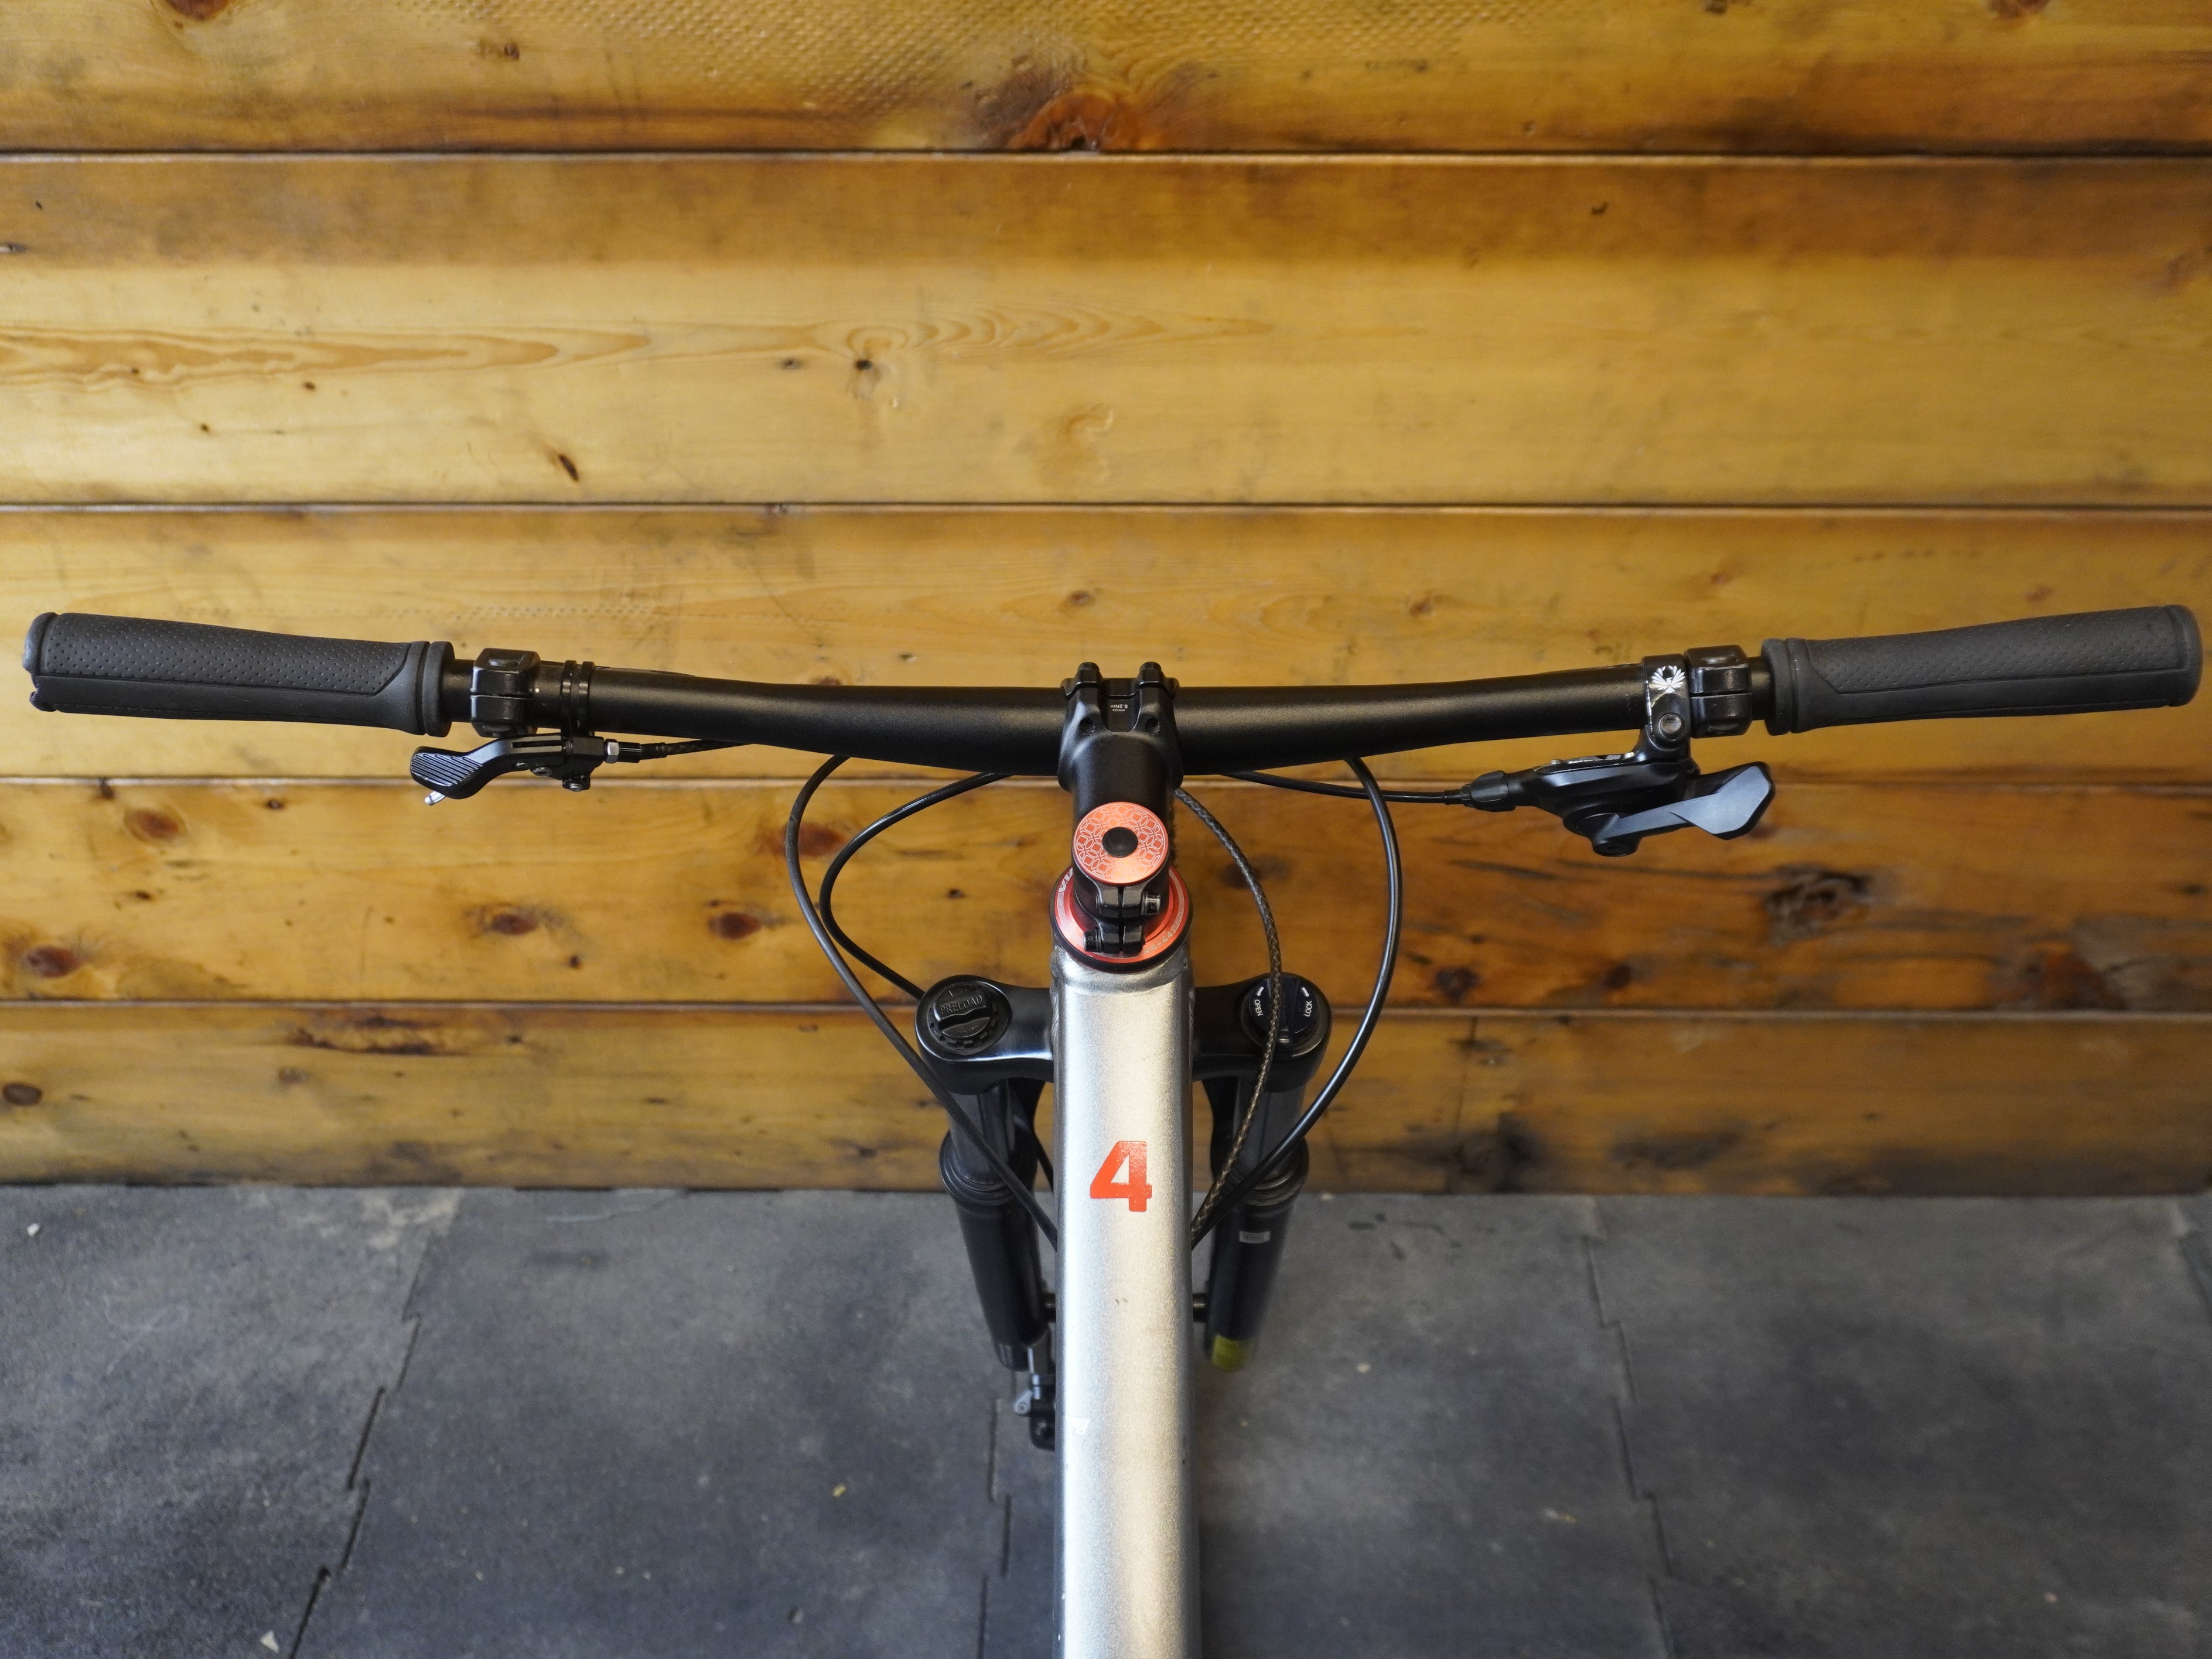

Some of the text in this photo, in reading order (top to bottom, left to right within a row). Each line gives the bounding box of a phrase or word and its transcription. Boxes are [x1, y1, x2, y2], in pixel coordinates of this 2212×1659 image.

[939, 994, 983, 1015] PRELOAD
[1254, 999, 1264, 1016] OPEN
[1303, 1000, 1313, 1018] LOCK
[1090, 1141, 1152, 1212] 4
